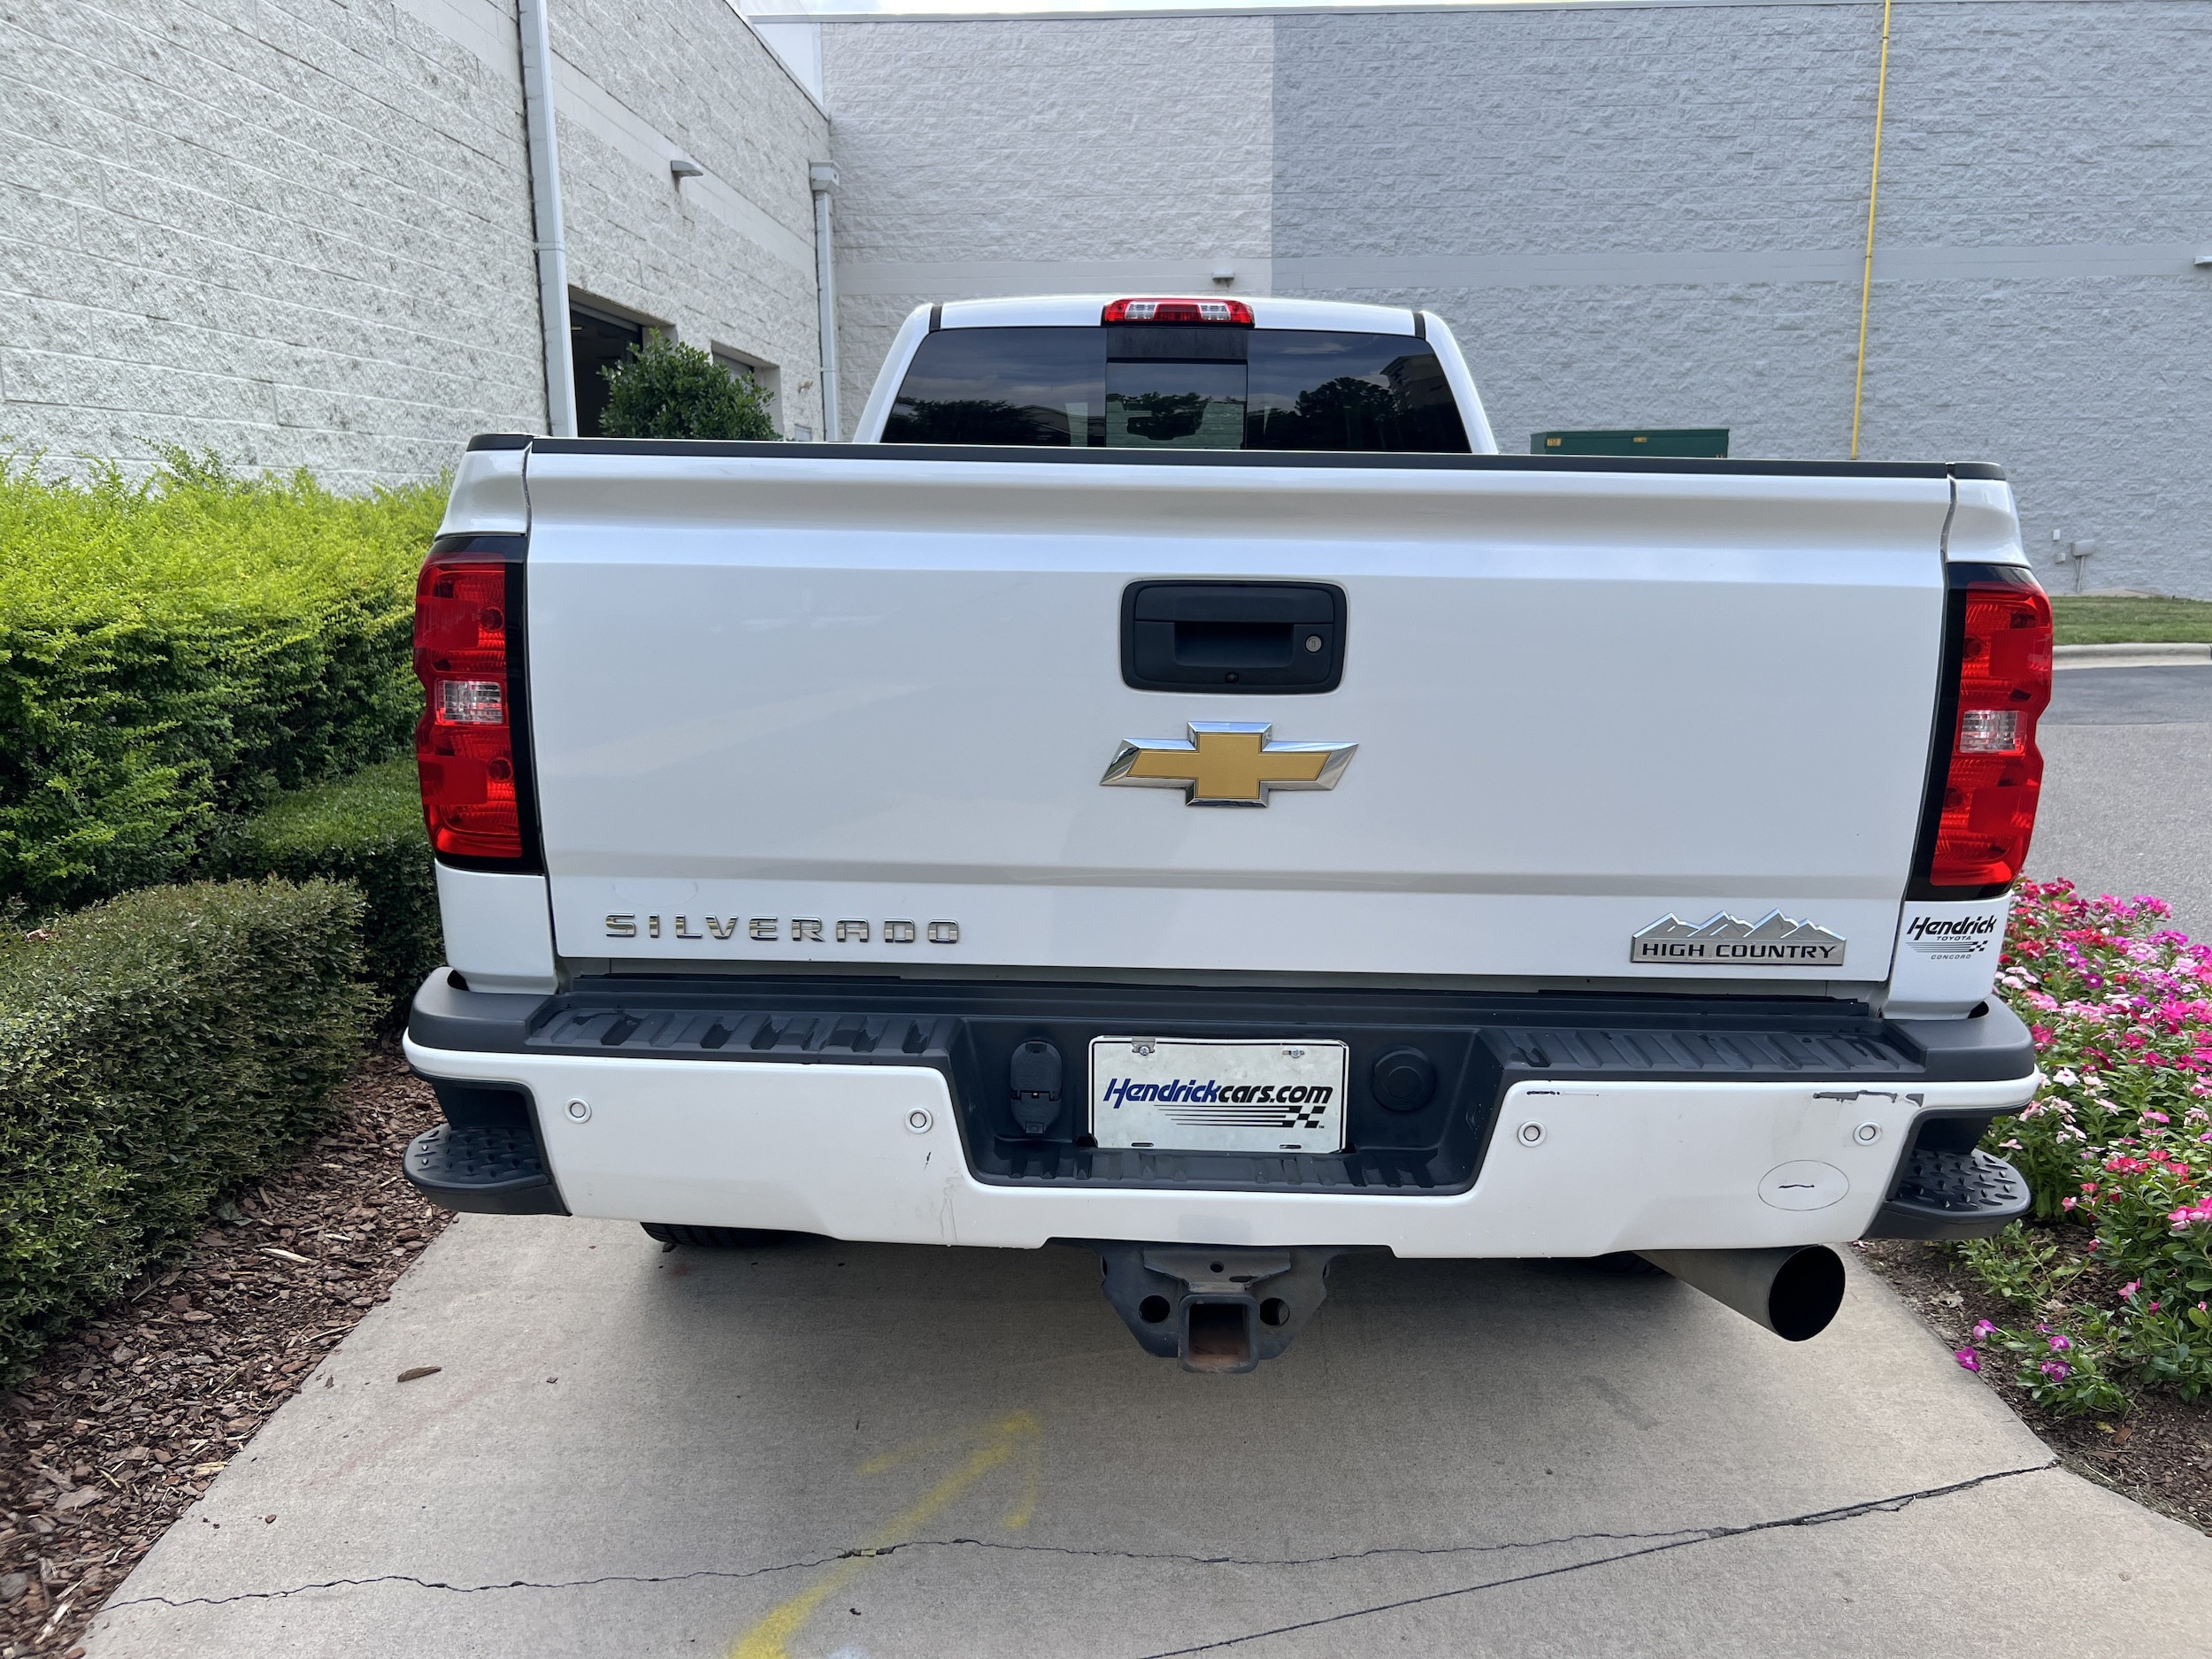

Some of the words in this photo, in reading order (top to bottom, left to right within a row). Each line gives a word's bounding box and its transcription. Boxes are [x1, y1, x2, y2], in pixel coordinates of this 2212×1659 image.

[605, 912, 959, 943] SILVERADO
[1906, 915, 1997, 941] Hendrick
[1642, 943, 1705, 956] HIGH
[1716, 944, 1836, 958] COUNTRY
[1102, 1078, 1333, 1109] Hendrickcars.com
